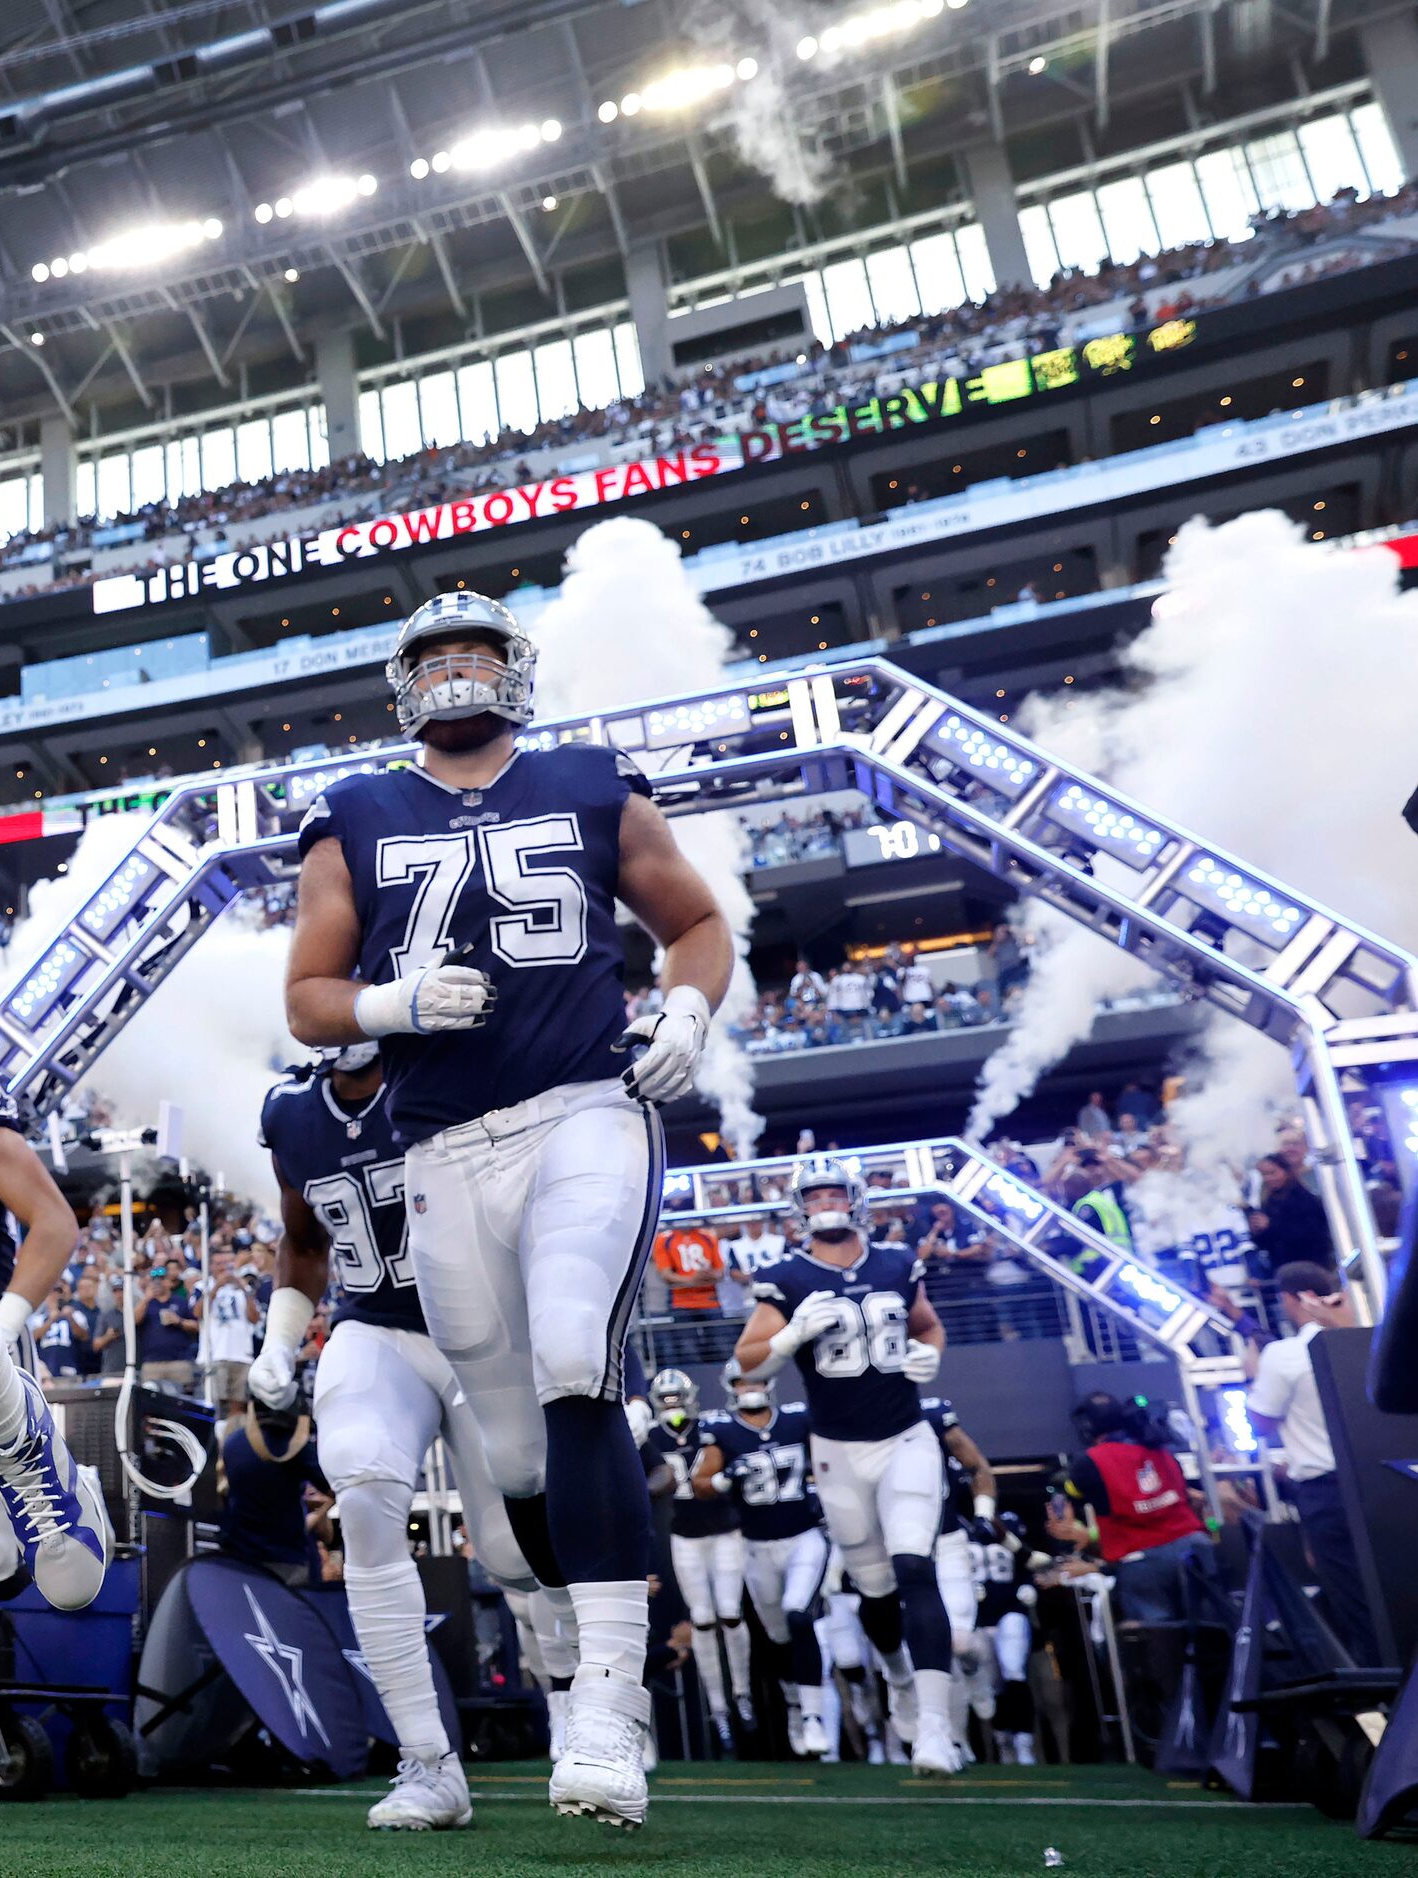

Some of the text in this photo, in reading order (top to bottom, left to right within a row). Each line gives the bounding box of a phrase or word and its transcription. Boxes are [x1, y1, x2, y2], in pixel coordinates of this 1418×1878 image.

[135, 372, 984, 604] THE ONE COWBOYS FANS DESERVE
[741, 556, 766, 576] 74
[778, 546, 823, 569] BOB
[832, 532, 885, 557] LILLY
[300, 651, 338, 670] DON
[376, 813, 587, 980] 75
[303, 1157, 416, 1292] 97
[1194, 1229, 1240, 1269] 22
